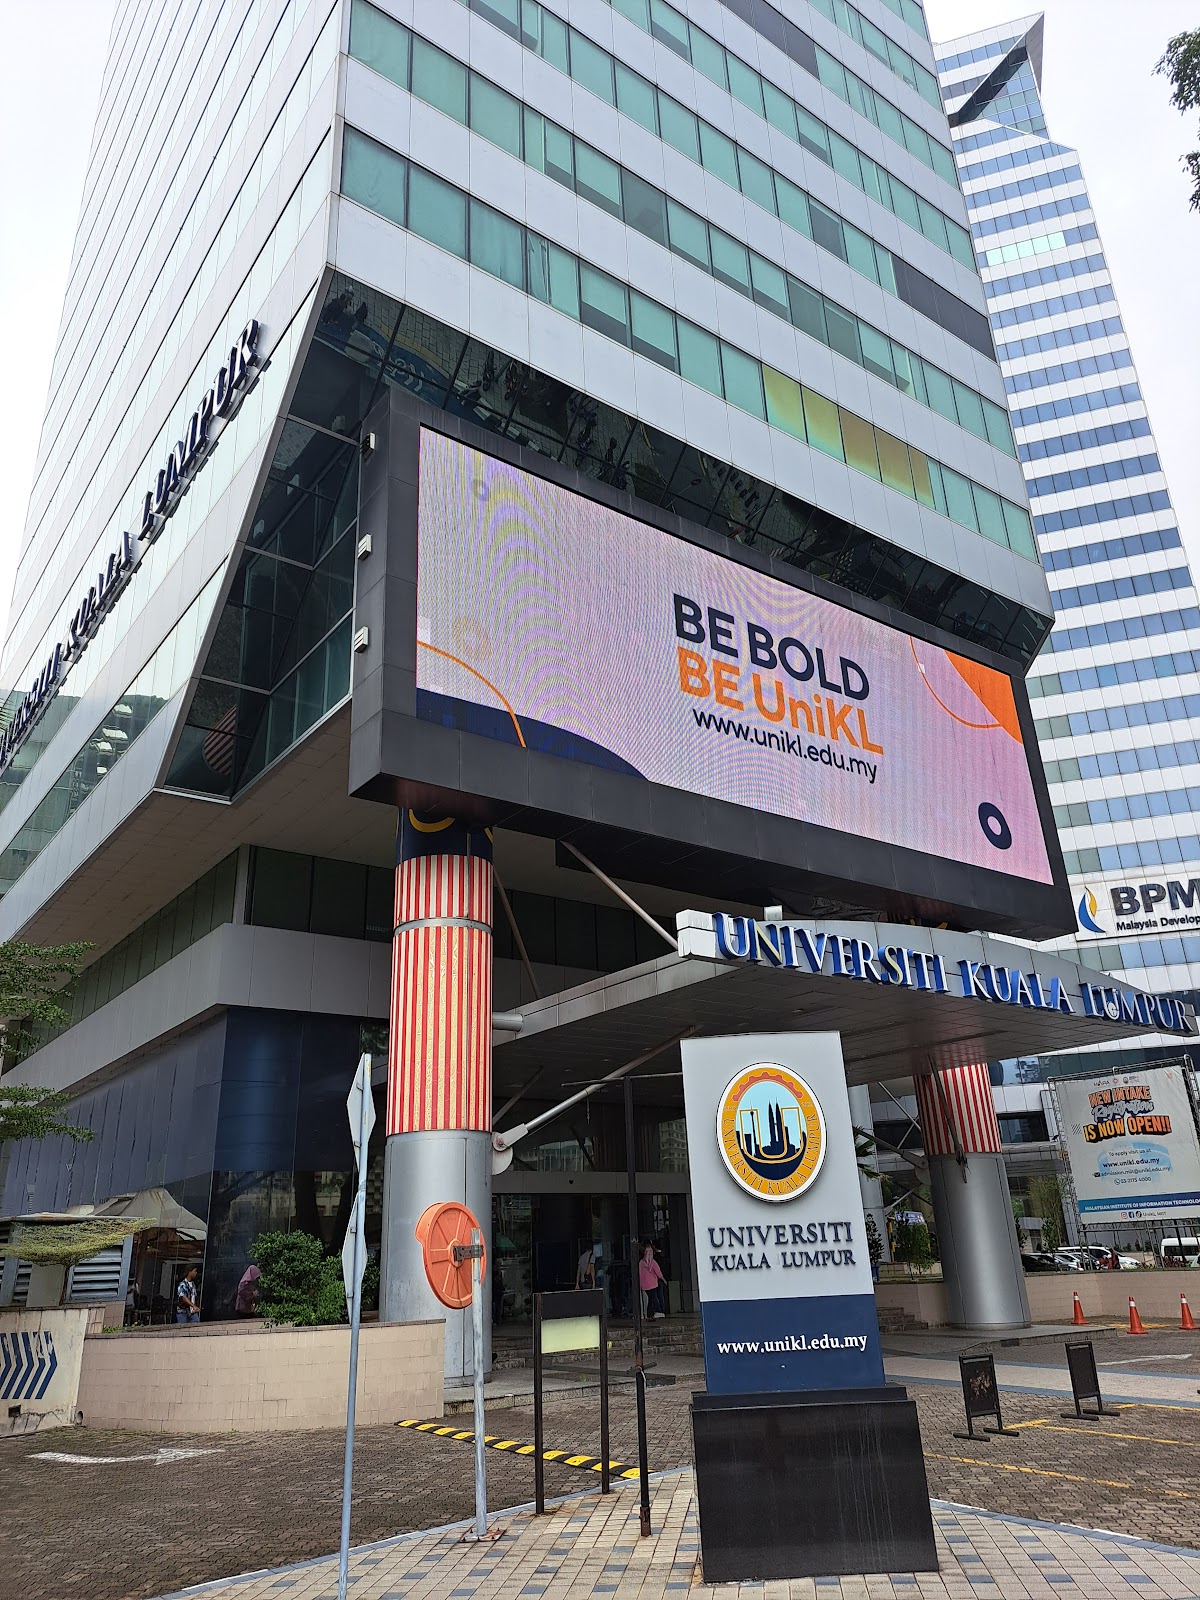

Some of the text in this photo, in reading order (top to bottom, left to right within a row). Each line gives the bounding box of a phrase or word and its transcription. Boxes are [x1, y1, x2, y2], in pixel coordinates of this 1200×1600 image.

[673, 592, 870, 700] BE BOLD
[677, 645, 884, 755] BE UniKL
[692, 708, 877, 784] www.unikl.edu.my
[1116, 919, 1158, 932] Malaysia
[712, 911, 1194, 1032] UNIVERSITI KUALA LUMPUR
[1088, 1086, 1153, 1108] NEW INTAKE
[1083, 1115, 1172, 1142] IS NOW OPEN!!
[723, 1113, 820, 1195] UNIVERSITI KUALA LUMPUR
[1103, 1157, 1160, 1168] www.unikl.edu.my
[1139, 1200, 1173, 1208] INFORMATION
[708, 1221, 854, 1249] UNIVERSITI
[710, 1249, 856, 1272] KUALA LUMPUR
[717, 1333, 868, 1354] www.unikl.edu.my
